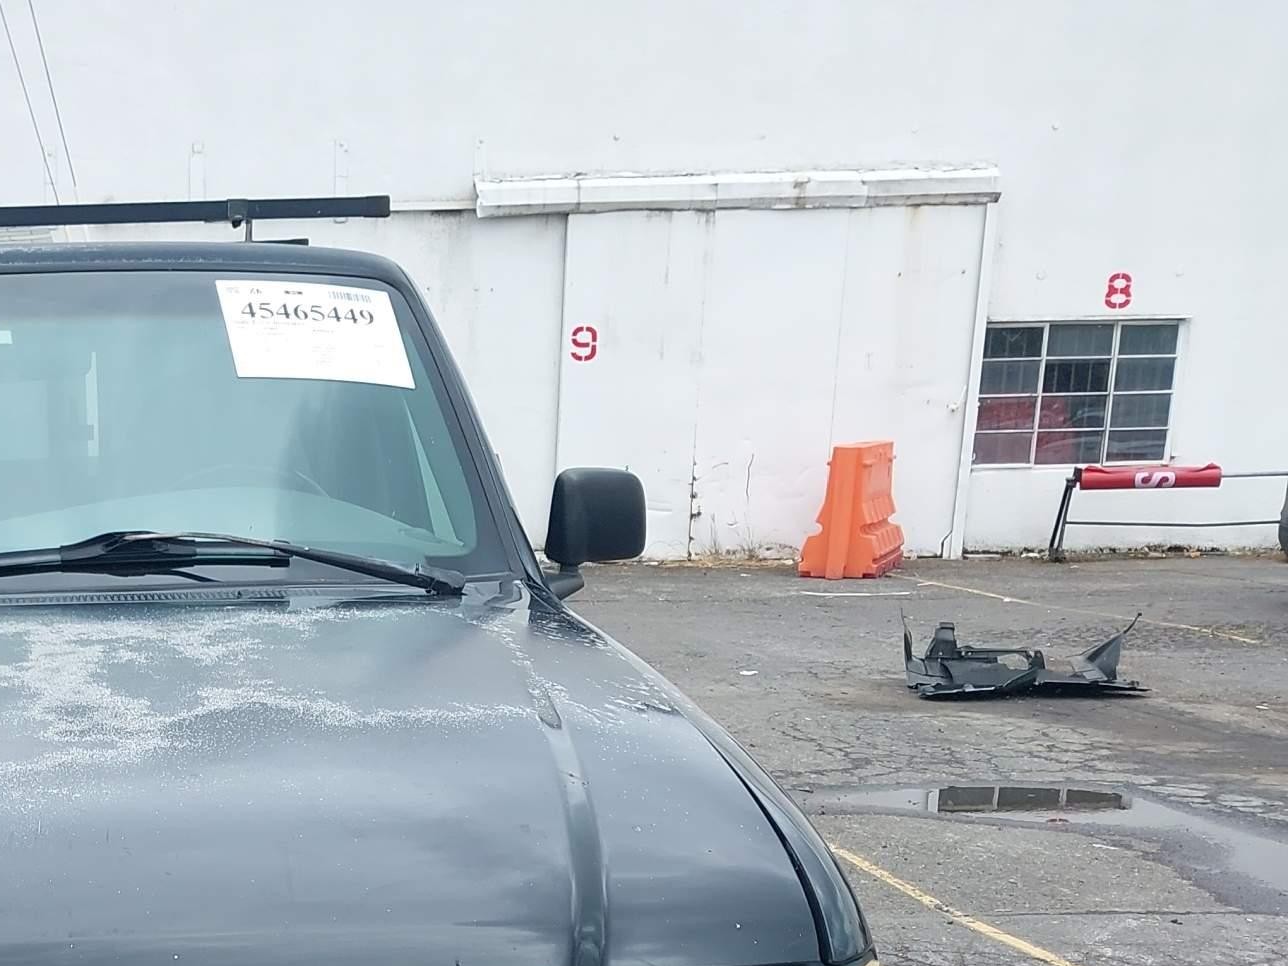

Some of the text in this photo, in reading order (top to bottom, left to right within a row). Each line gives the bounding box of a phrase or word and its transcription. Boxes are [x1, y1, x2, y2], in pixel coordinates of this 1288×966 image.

[1105, 272, 1133, 309] 8
[240, 301, 374, 325] 45465449
[570, 325, 598, 362] 9
